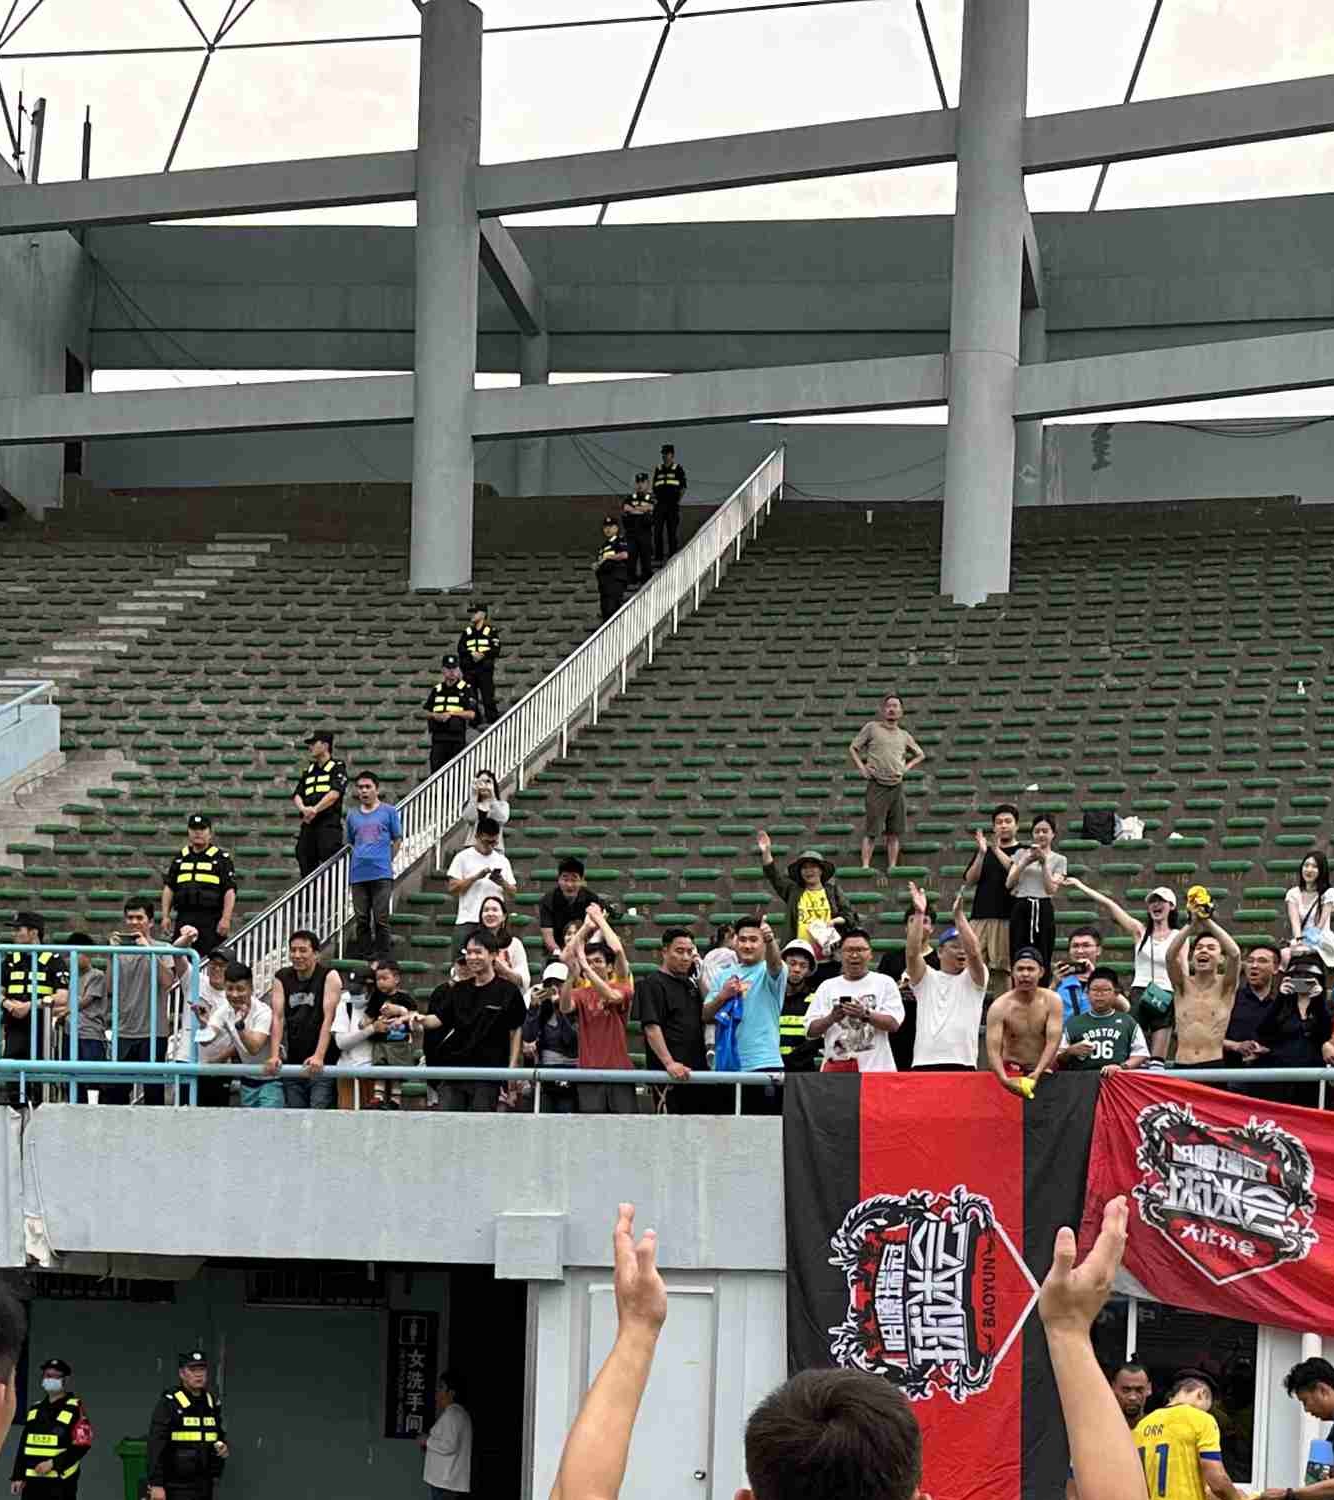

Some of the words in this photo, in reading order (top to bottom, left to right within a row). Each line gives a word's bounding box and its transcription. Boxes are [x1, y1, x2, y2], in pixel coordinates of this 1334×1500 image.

[910, 1221, 970, 1366] 球迷会
[982, 1256, 996, 1329] BAOYUN
[406, 1348, 426, 1433] 女洗手间
